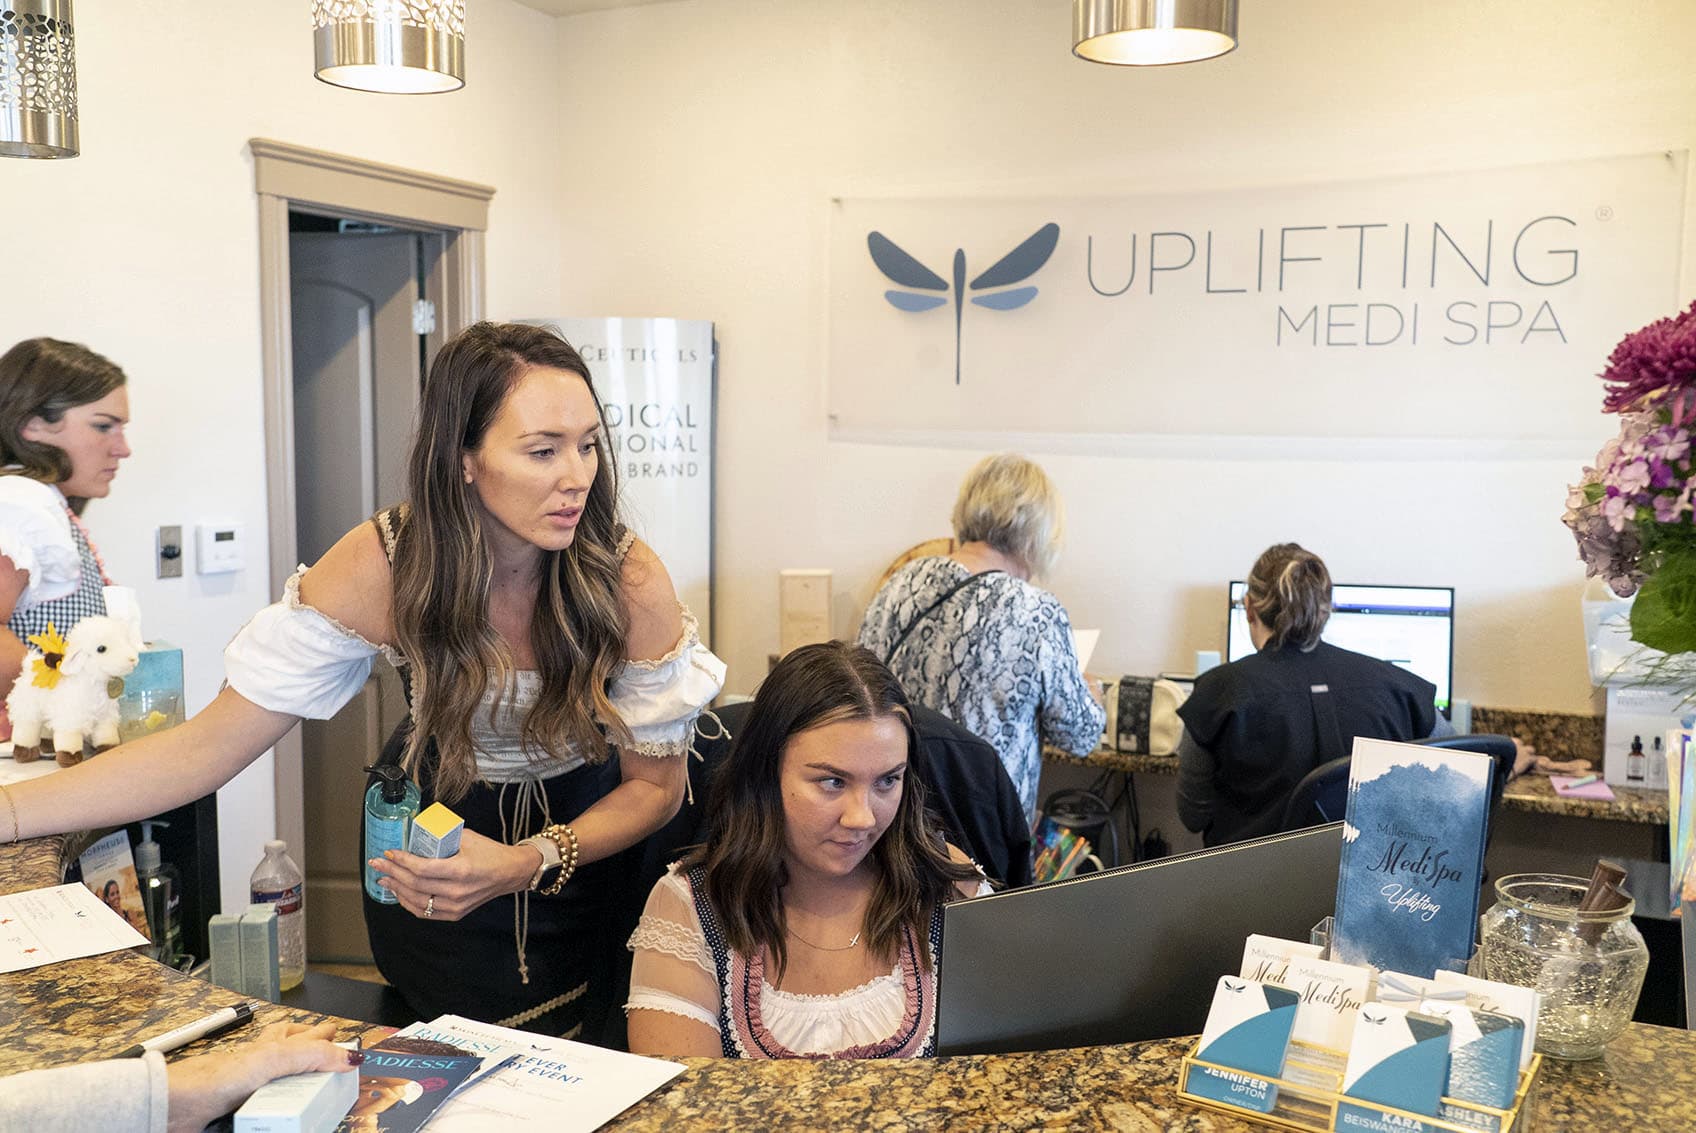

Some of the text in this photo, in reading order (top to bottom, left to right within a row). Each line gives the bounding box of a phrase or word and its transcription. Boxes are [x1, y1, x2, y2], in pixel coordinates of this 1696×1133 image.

[1087, 216, 1579, 297] UPLIFTING
[1277, 300, 1568, 347] MEDI SPA
[627, 462, 699, 478] BRAND
[1376, 822, 1439, 846] Millennium
[1380, 883, 1441, 922] Uplifting
[1242, 960, 1289, 984] Medi
[525, 1056, 567, 1071] EVER
[527, 1067, 584, 1084] EVENT
[1204, 1067, 1269, 1091] JENNIFER
[1230, 1083, 1266, 1101] UPTON
[1343, 1113, 1421, 1133] BEISWANG
[1381, 1112, 1424, 1132] KARA
